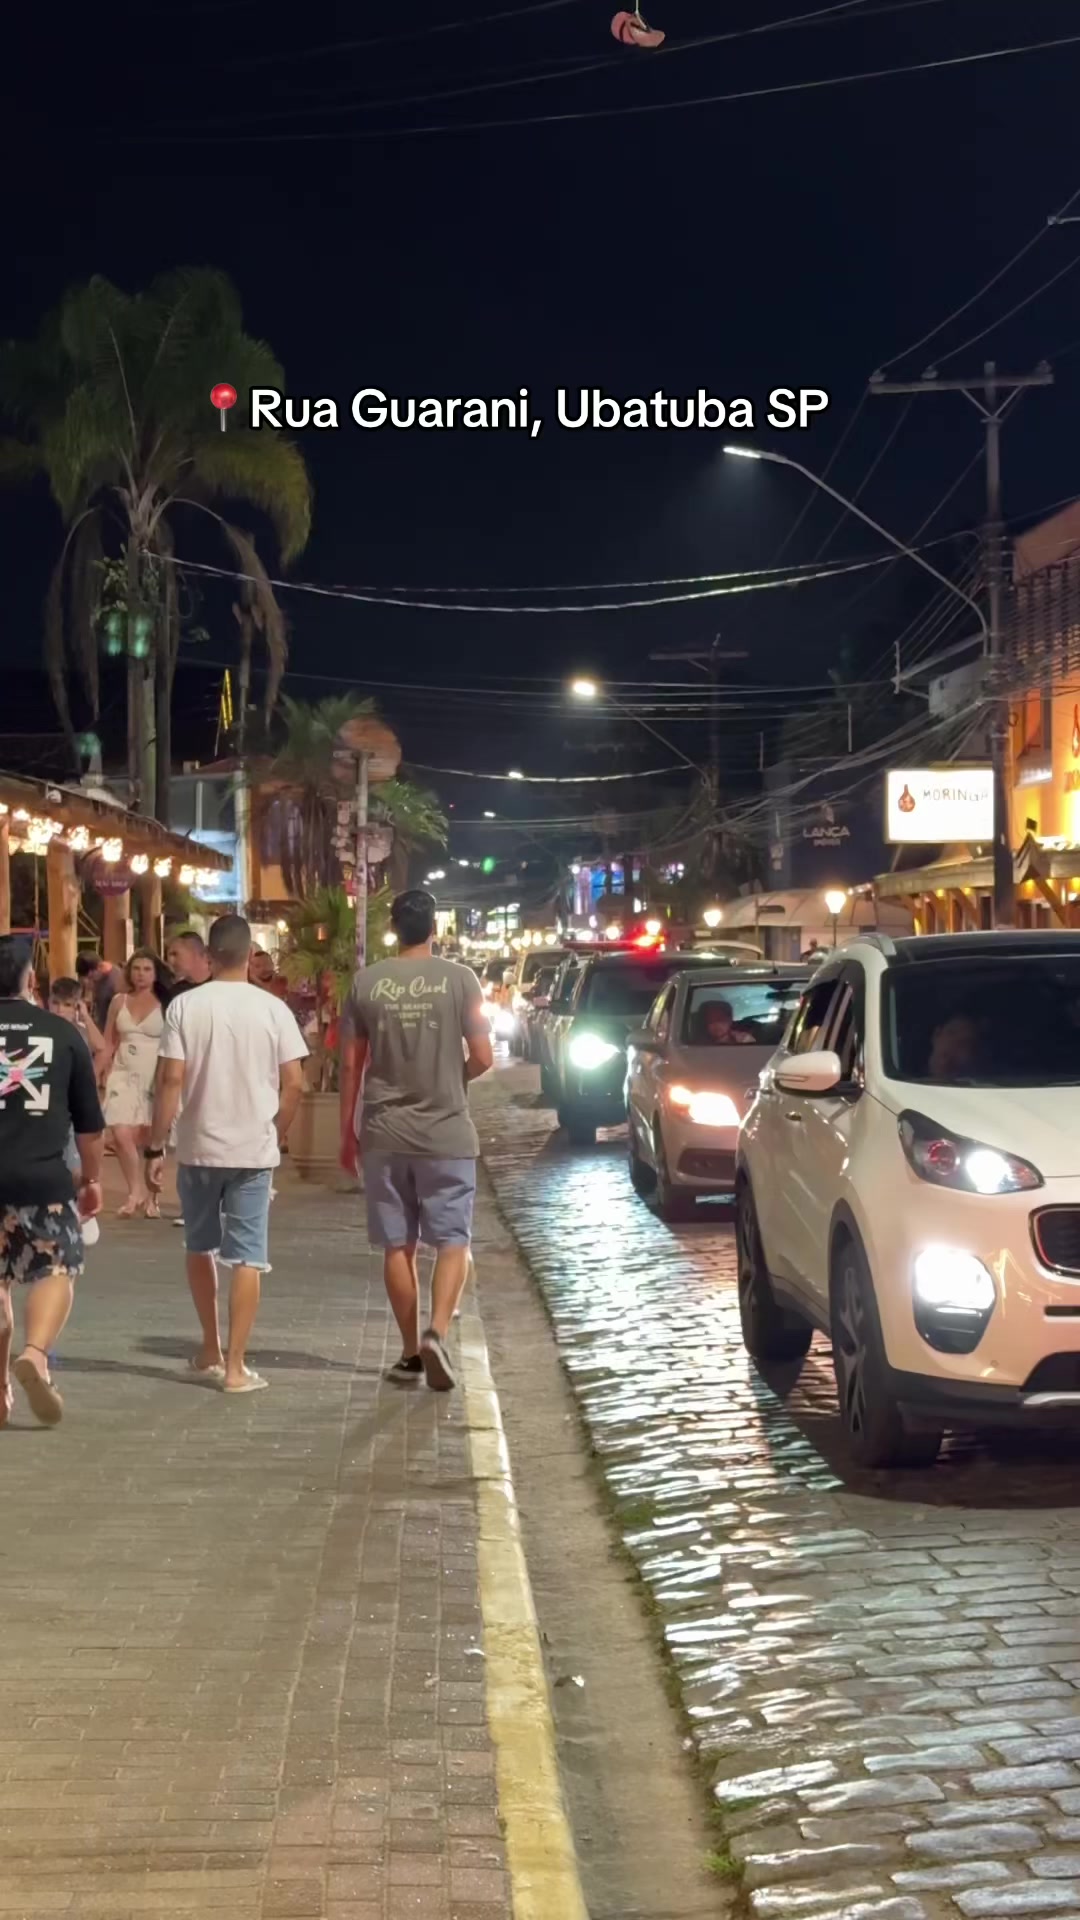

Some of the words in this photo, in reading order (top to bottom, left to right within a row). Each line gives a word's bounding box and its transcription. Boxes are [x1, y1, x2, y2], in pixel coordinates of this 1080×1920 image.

[923, 787, 989, 801] MORINGA
[370, 978, 406, 1001] Rip
[409, 976, 448, 998] Curl
